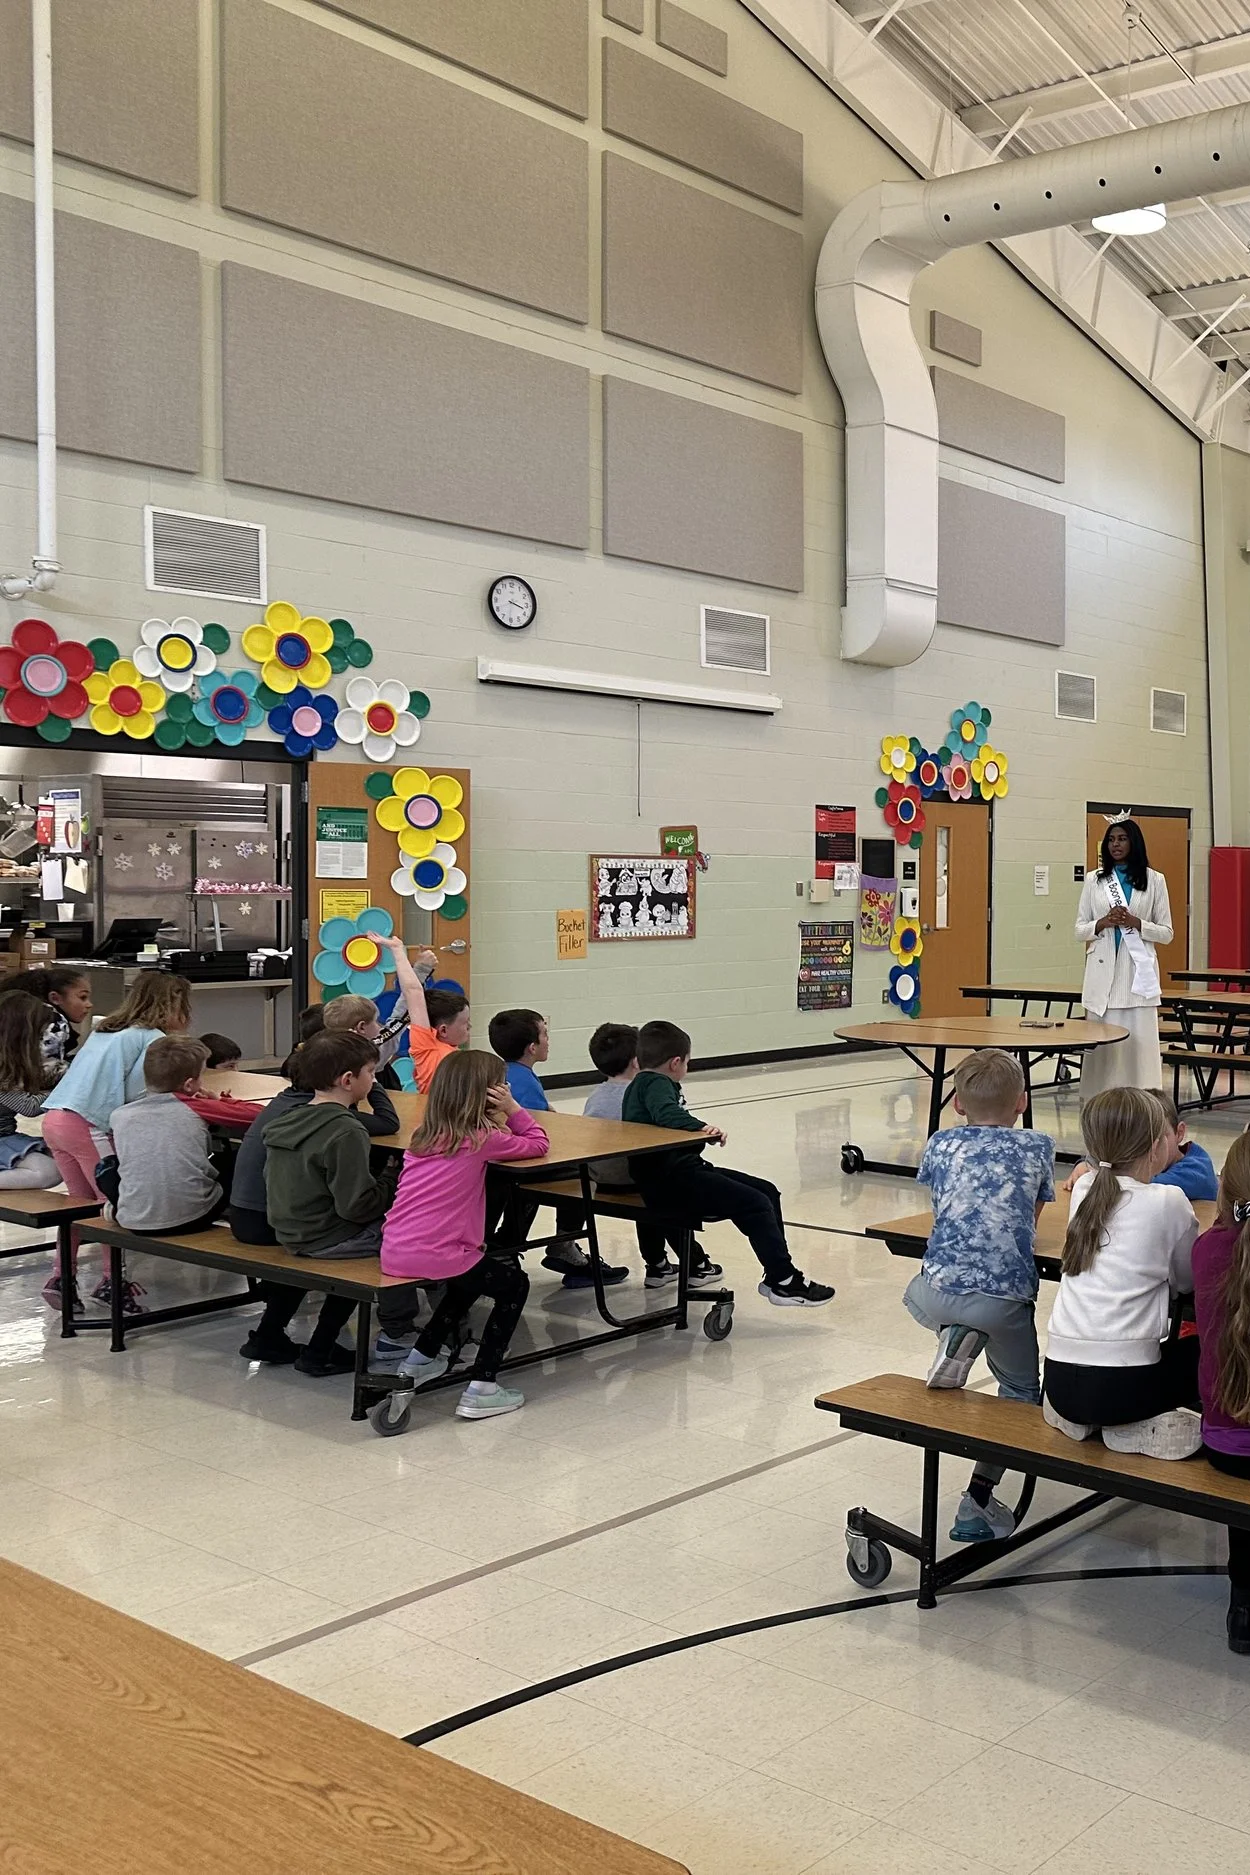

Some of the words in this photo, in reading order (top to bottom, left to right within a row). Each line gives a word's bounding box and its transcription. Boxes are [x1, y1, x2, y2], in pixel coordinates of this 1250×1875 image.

[1109, 882, 1123, 907] Boone
[557, 918, 586, 933] Bucket
[559, 934, 584, 953] Filler
